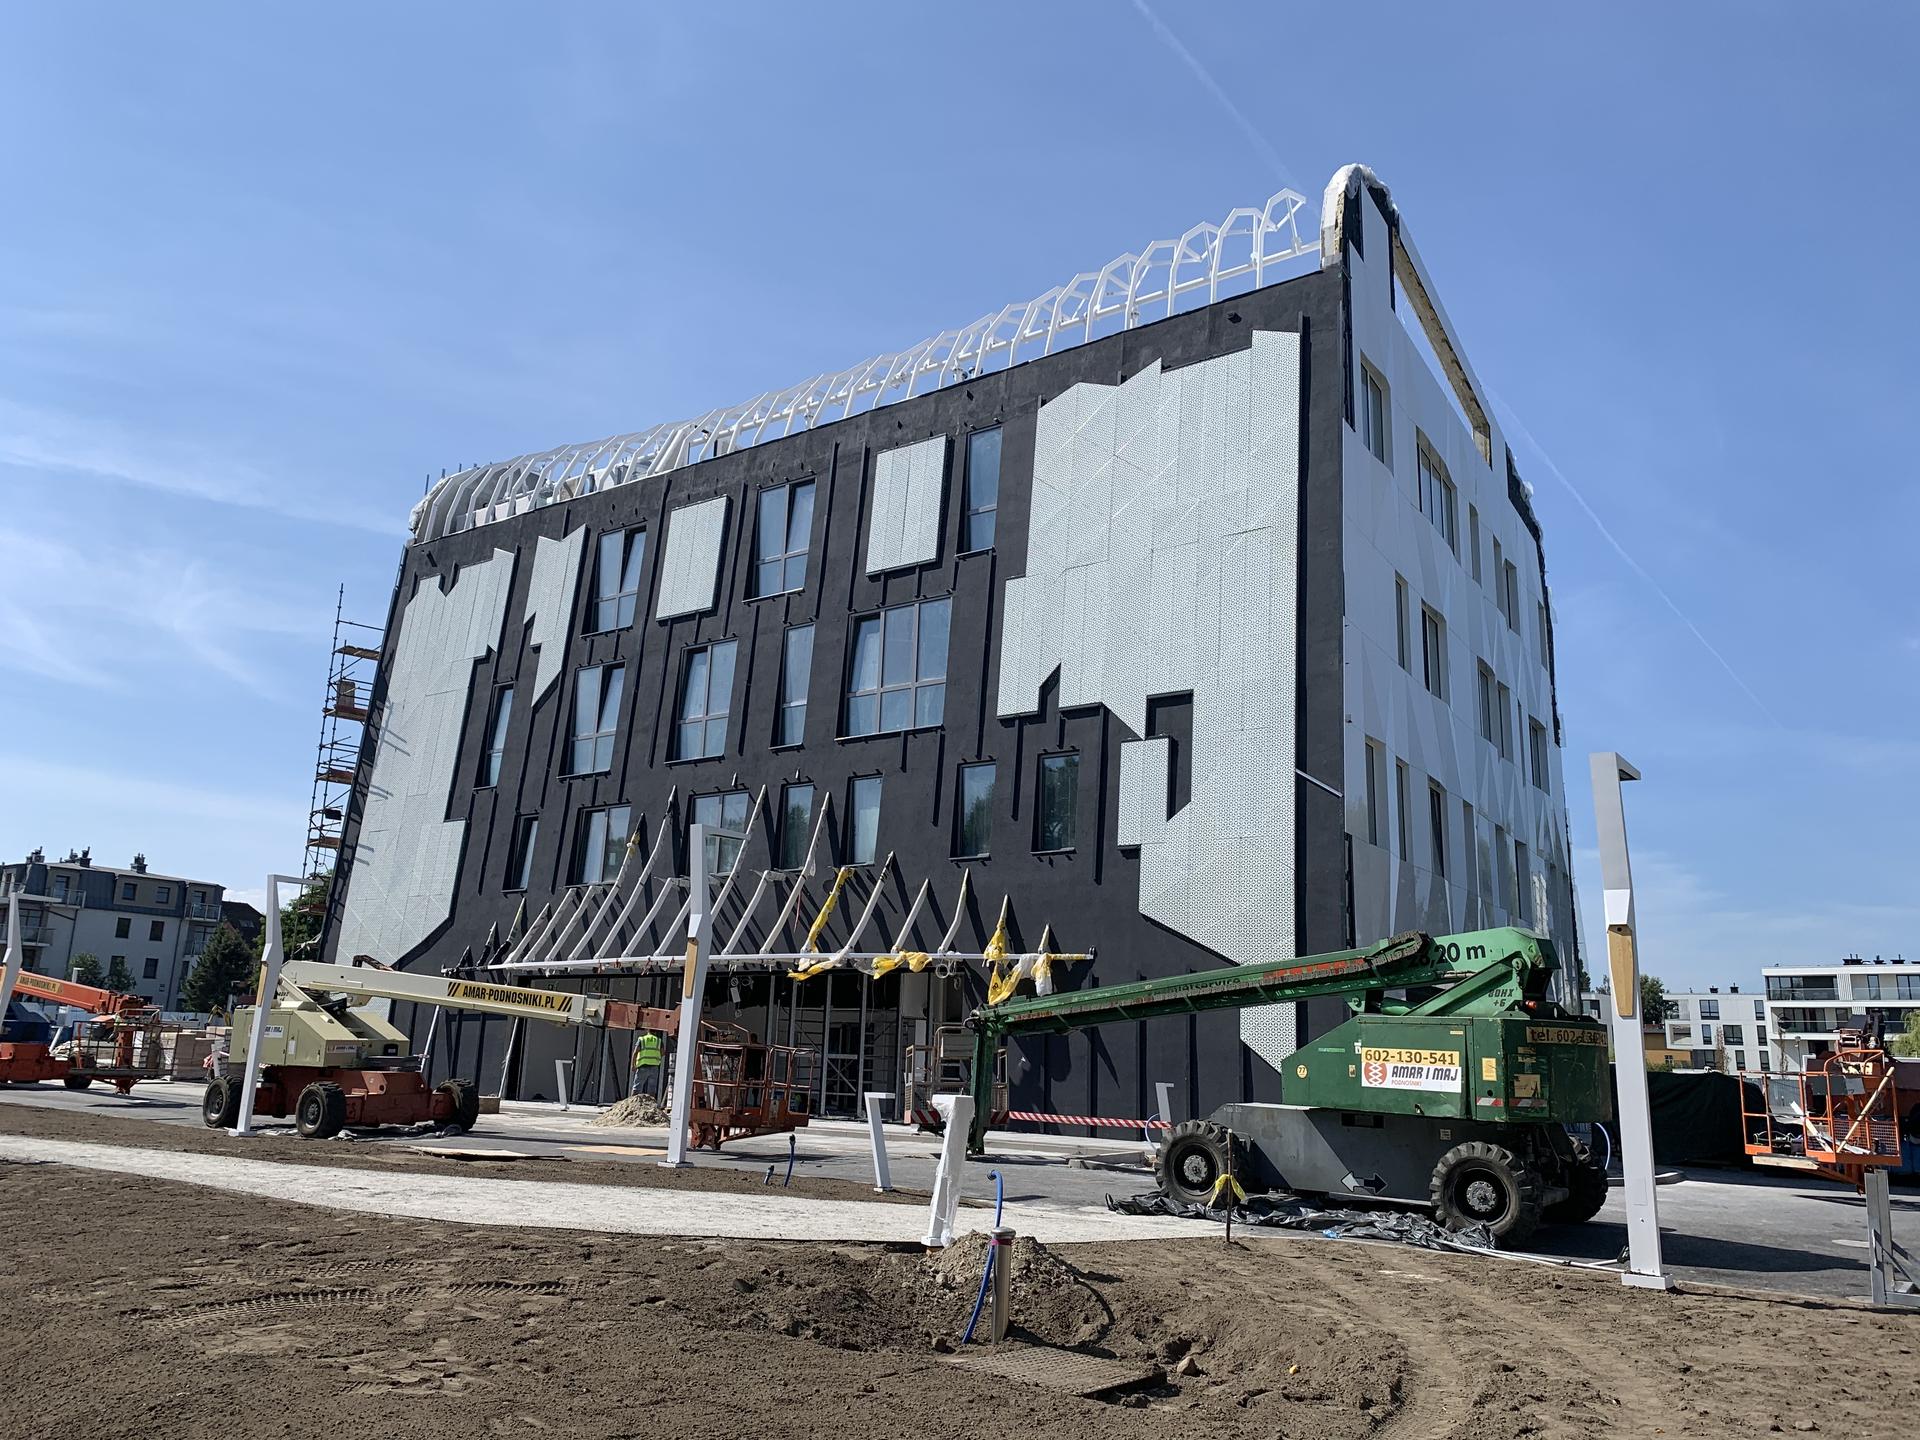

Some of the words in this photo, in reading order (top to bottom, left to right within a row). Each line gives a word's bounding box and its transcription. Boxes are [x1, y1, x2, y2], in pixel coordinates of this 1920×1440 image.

[462, 985, 556, 1009] AMAR-PODNOSNIKI.PL
[1364, 1048, 1456, 1066] 602-130-541
[1391, 1065, 1424, 1080] AMAR
[1432, 1067, 1459, 1082] MAJ
